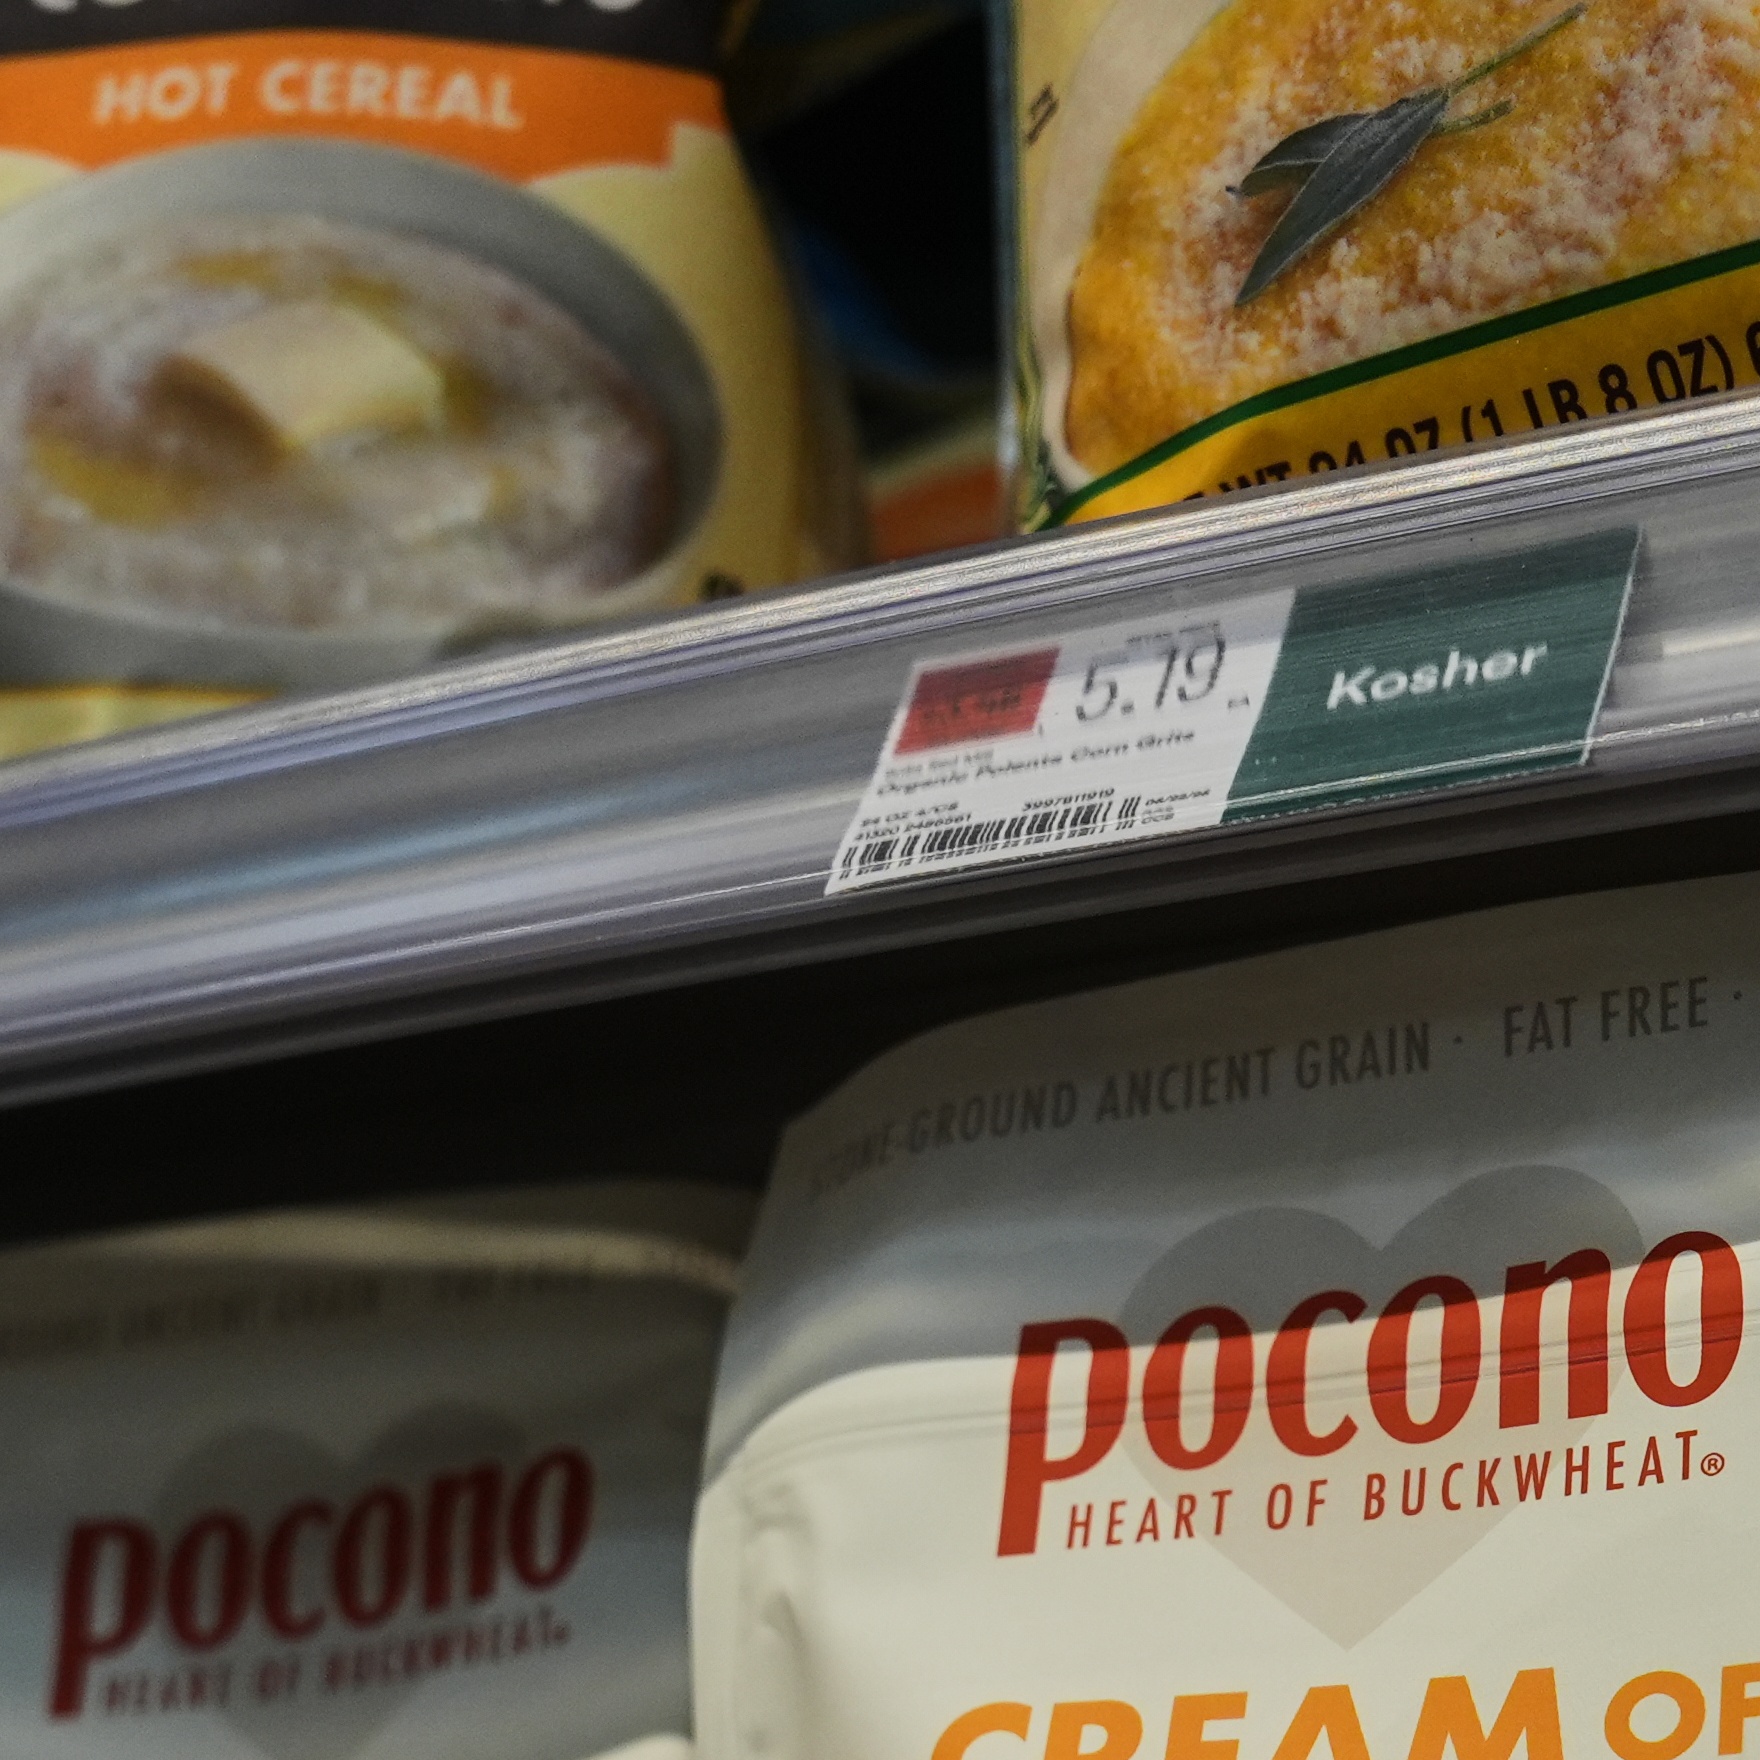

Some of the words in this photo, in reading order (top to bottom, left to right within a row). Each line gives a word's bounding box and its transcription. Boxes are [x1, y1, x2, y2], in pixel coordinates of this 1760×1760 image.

[94, 62, 238, 126] HOT
[259, 58, 525, 132] CEREAL
[1598, 363, 1638, 415] 8
[1647, 332, 1737, 401] OZ)
[1076, 630, 1227, 724] 5.79
[1326, 641, 1548, 712] Kosher
[1094, 1047, 1278, 1123] ANCIENT
[1293, 1020, 1432, 1089] GRAIN
[1503, 996, 1578, 1057] FAT
[1599, 976, 1709, 1043] FREE
[997, 1230, 1744, 1557] pocono
[1066, 1490, 1233, 1550] HEART
[1266, 1478, 1328, 1531] OF
[48, 1444, 597, 1722] pocono
